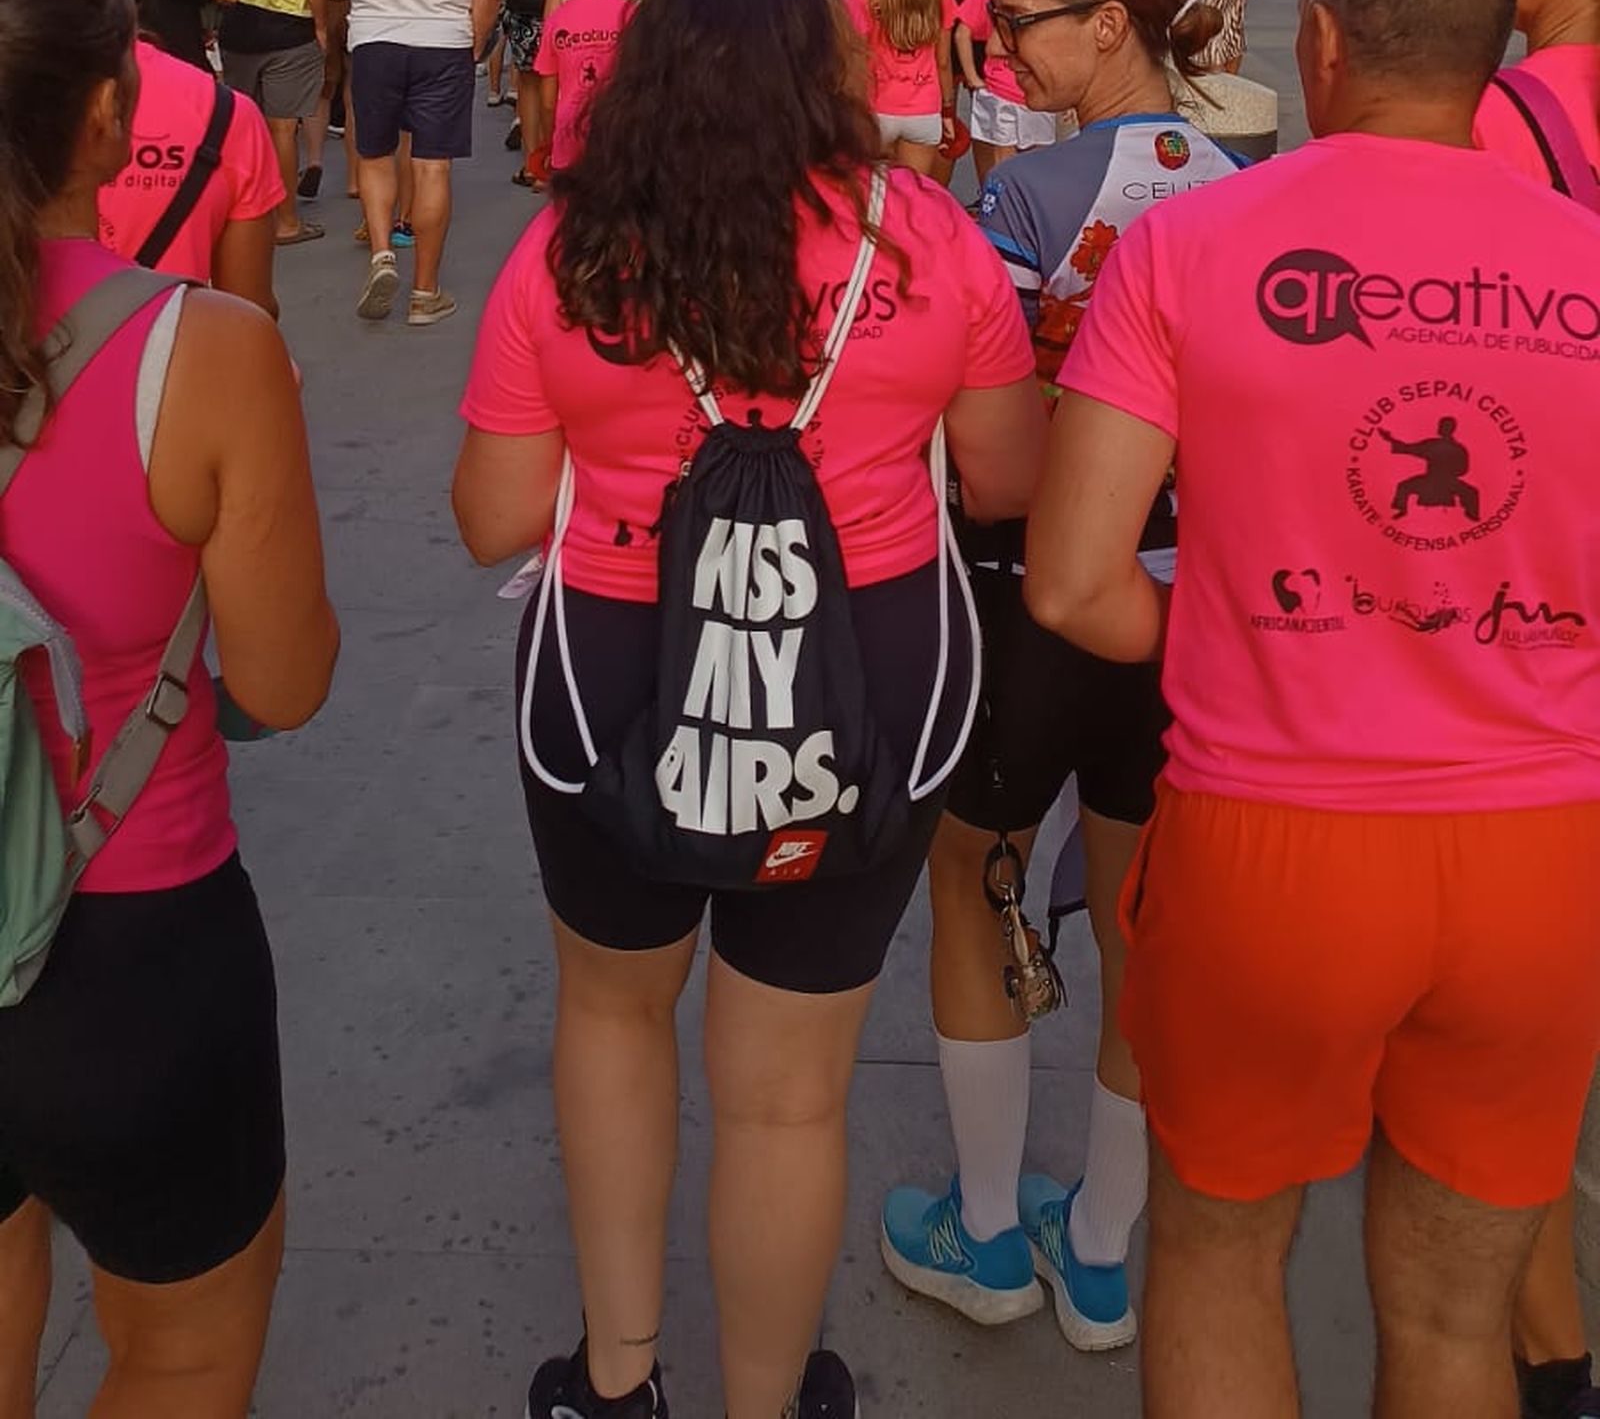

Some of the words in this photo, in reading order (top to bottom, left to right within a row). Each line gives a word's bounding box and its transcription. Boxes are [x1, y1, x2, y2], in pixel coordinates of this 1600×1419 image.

[125, 175, 183, 190] digita
[1387, 327, 1477, 347] AGENCIA
[1484, 333, 1508, 350] DE
[1515, 336, 1600, 362] PUBLICIDA
[1349, 396, 1396, 452] CLUB
[1399, 380, 1473, 403] SEPAI
[1477, 395, 1527, 461] CEUTA
[1346, 467, 1381, 526] KARATE
[1382, 525, 1459, 552] DEFENSA
[1460, 482, 1525, 545] PERSONAL
[683, 620, 804, 730] MY
